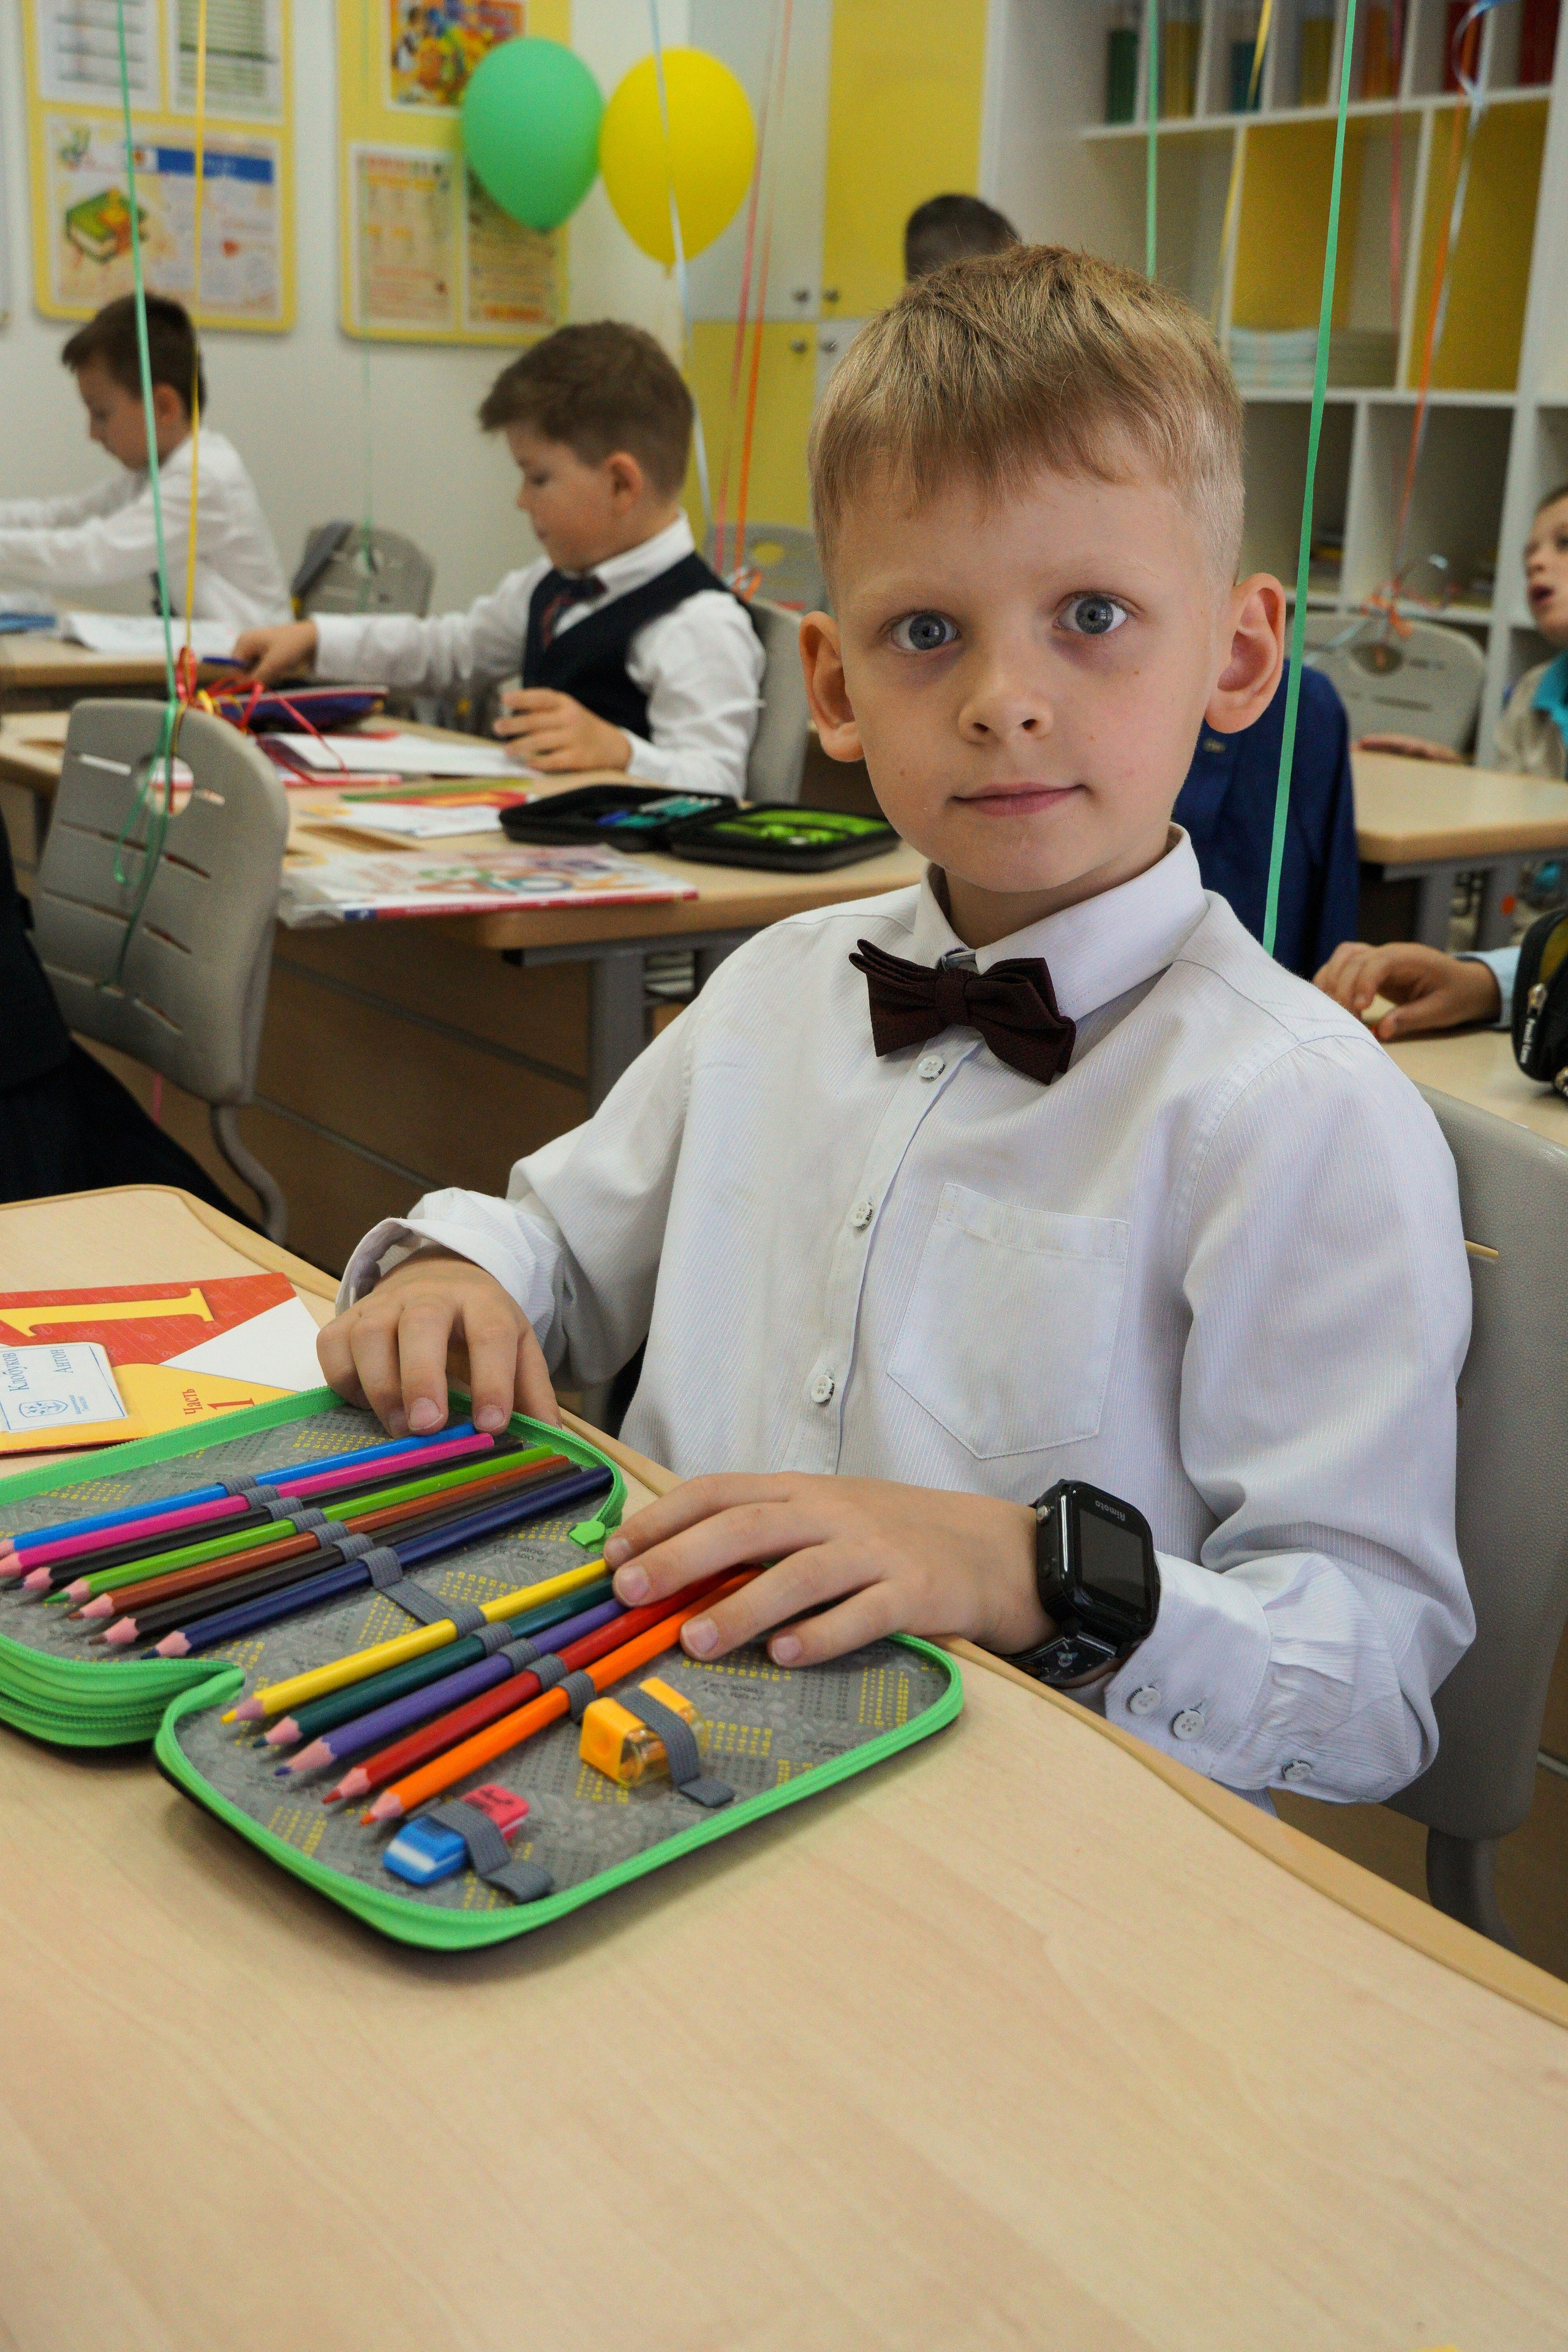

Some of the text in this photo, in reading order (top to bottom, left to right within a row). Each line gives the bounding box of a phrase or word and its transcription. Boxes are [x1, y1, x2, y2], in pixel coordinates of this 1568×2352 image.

[0, 1287, 215, 1337] 1
[2, 1352, 29, 1392] Клобуков
[50, 1349, 74, 1373] Антон
[182, 1389, 203, 1415] Часть
[207, 1397, 255, 1411] 1
[1095, 1500, 1126, 1522] Aimoto
